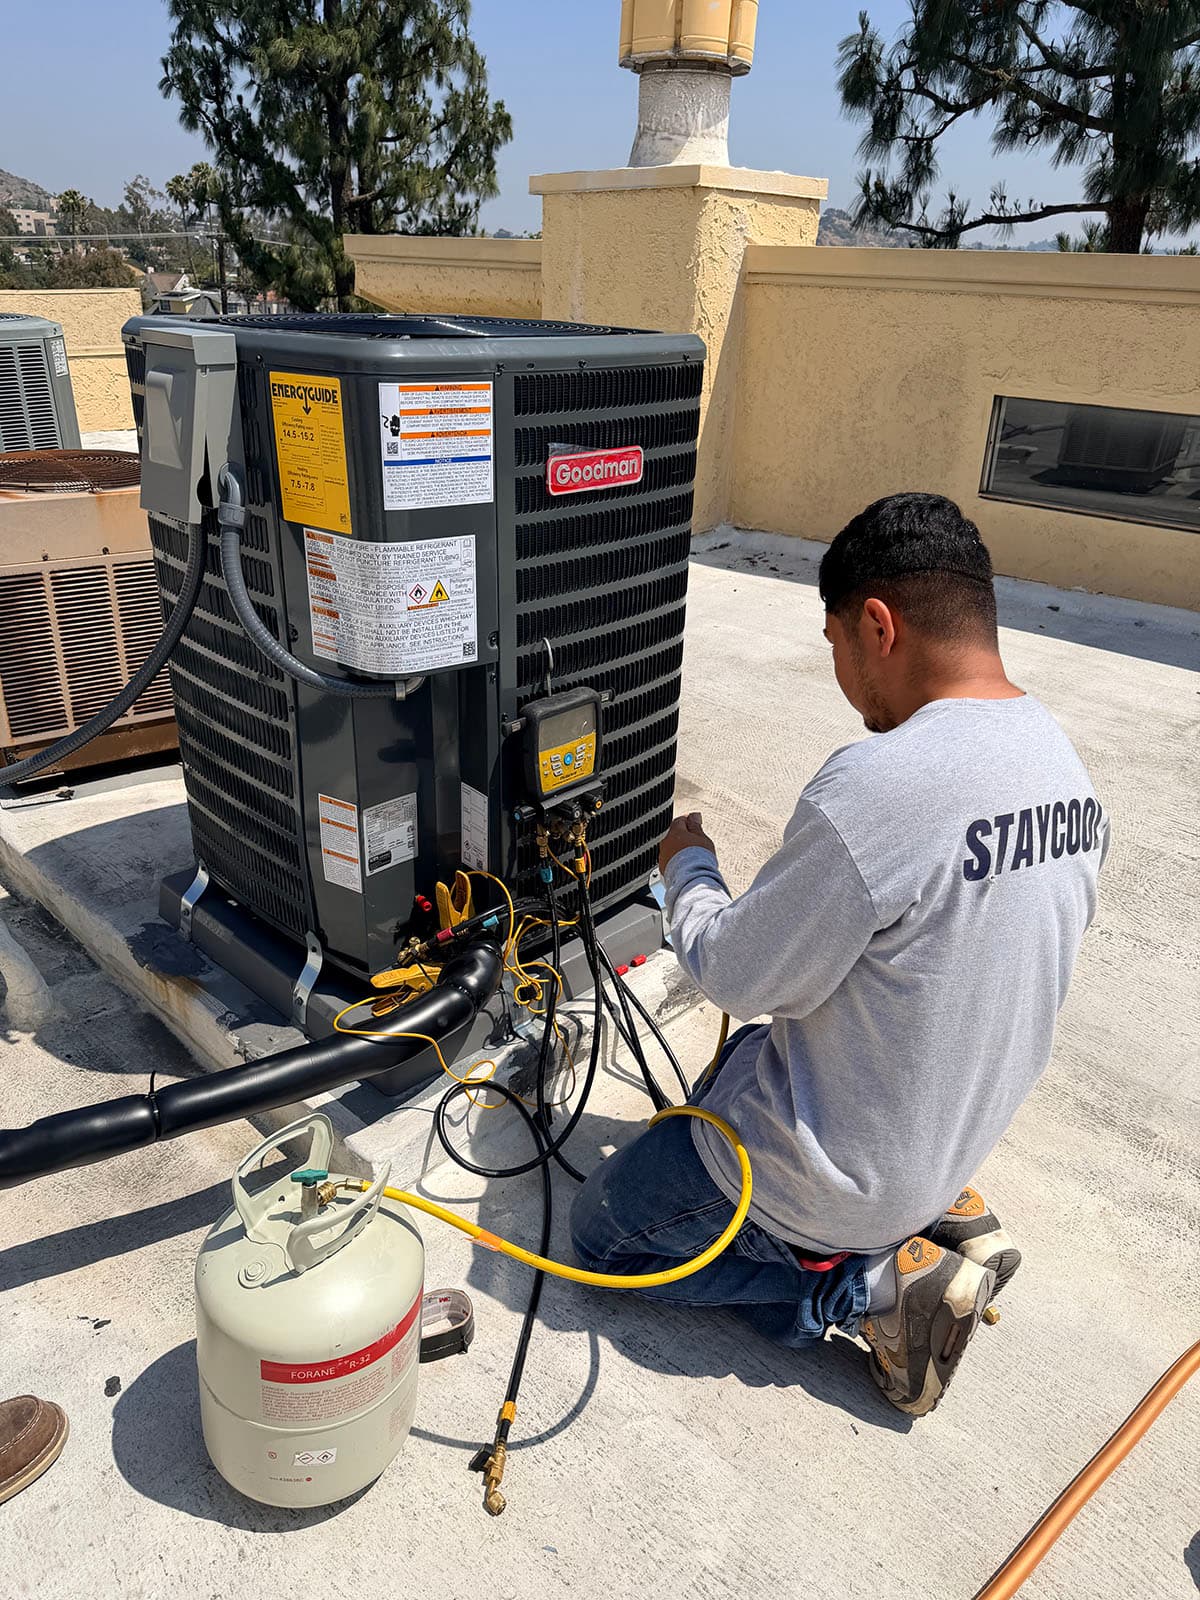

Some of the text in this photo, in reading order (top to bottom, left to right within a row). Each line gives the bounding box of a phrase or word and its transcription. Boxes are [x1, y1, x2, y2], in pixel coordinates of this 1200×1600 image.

[271, 383, 339, 404] ENERGYGUIDE
[556, 459, 638, 485] Goodman
[375, 545, 415, 553] FLAMMABLE
[415, 540, 457, 551] REFRIGERANT
[358, 557, 392, 567] PUNCTURE
[393, 557, 437, 567] REFRIGERANT
[438, 553, 460, 562] TUBING
[362, 552, 380, 560] ONLY
[393, 551, 421, 561] TRAINED
[421, 548, 447, 558] SERVICE
[348, 586, 388, 597] ACCORDANCE
[389, 590, 407, 598] WITH
[376, 582, 405, 591] DISPOSE
[355, 594, 401, 605] REGULATIONS
[376, 602, 395, 611] USED
[379, 621, 413, 630] AUXILIARY
[413, 617, 440, 628] DEVICES
[440, 614, 460, 623] WHICH
[460, 612, 473, 620] MAY
[375, 633, 409, 642] AUXILIARY
[409, 629, 436, 640] DEVICES
[436, 627, 457, 637] LISTED
[456, 625, 470, 633] FOR
[385, 628, 401, 637] NOT
[411, 622, 444, 634] INSTALLED
[409, 640, 421, 649] SEE
[290, 1353, 371, 1380] FORANE R-32
